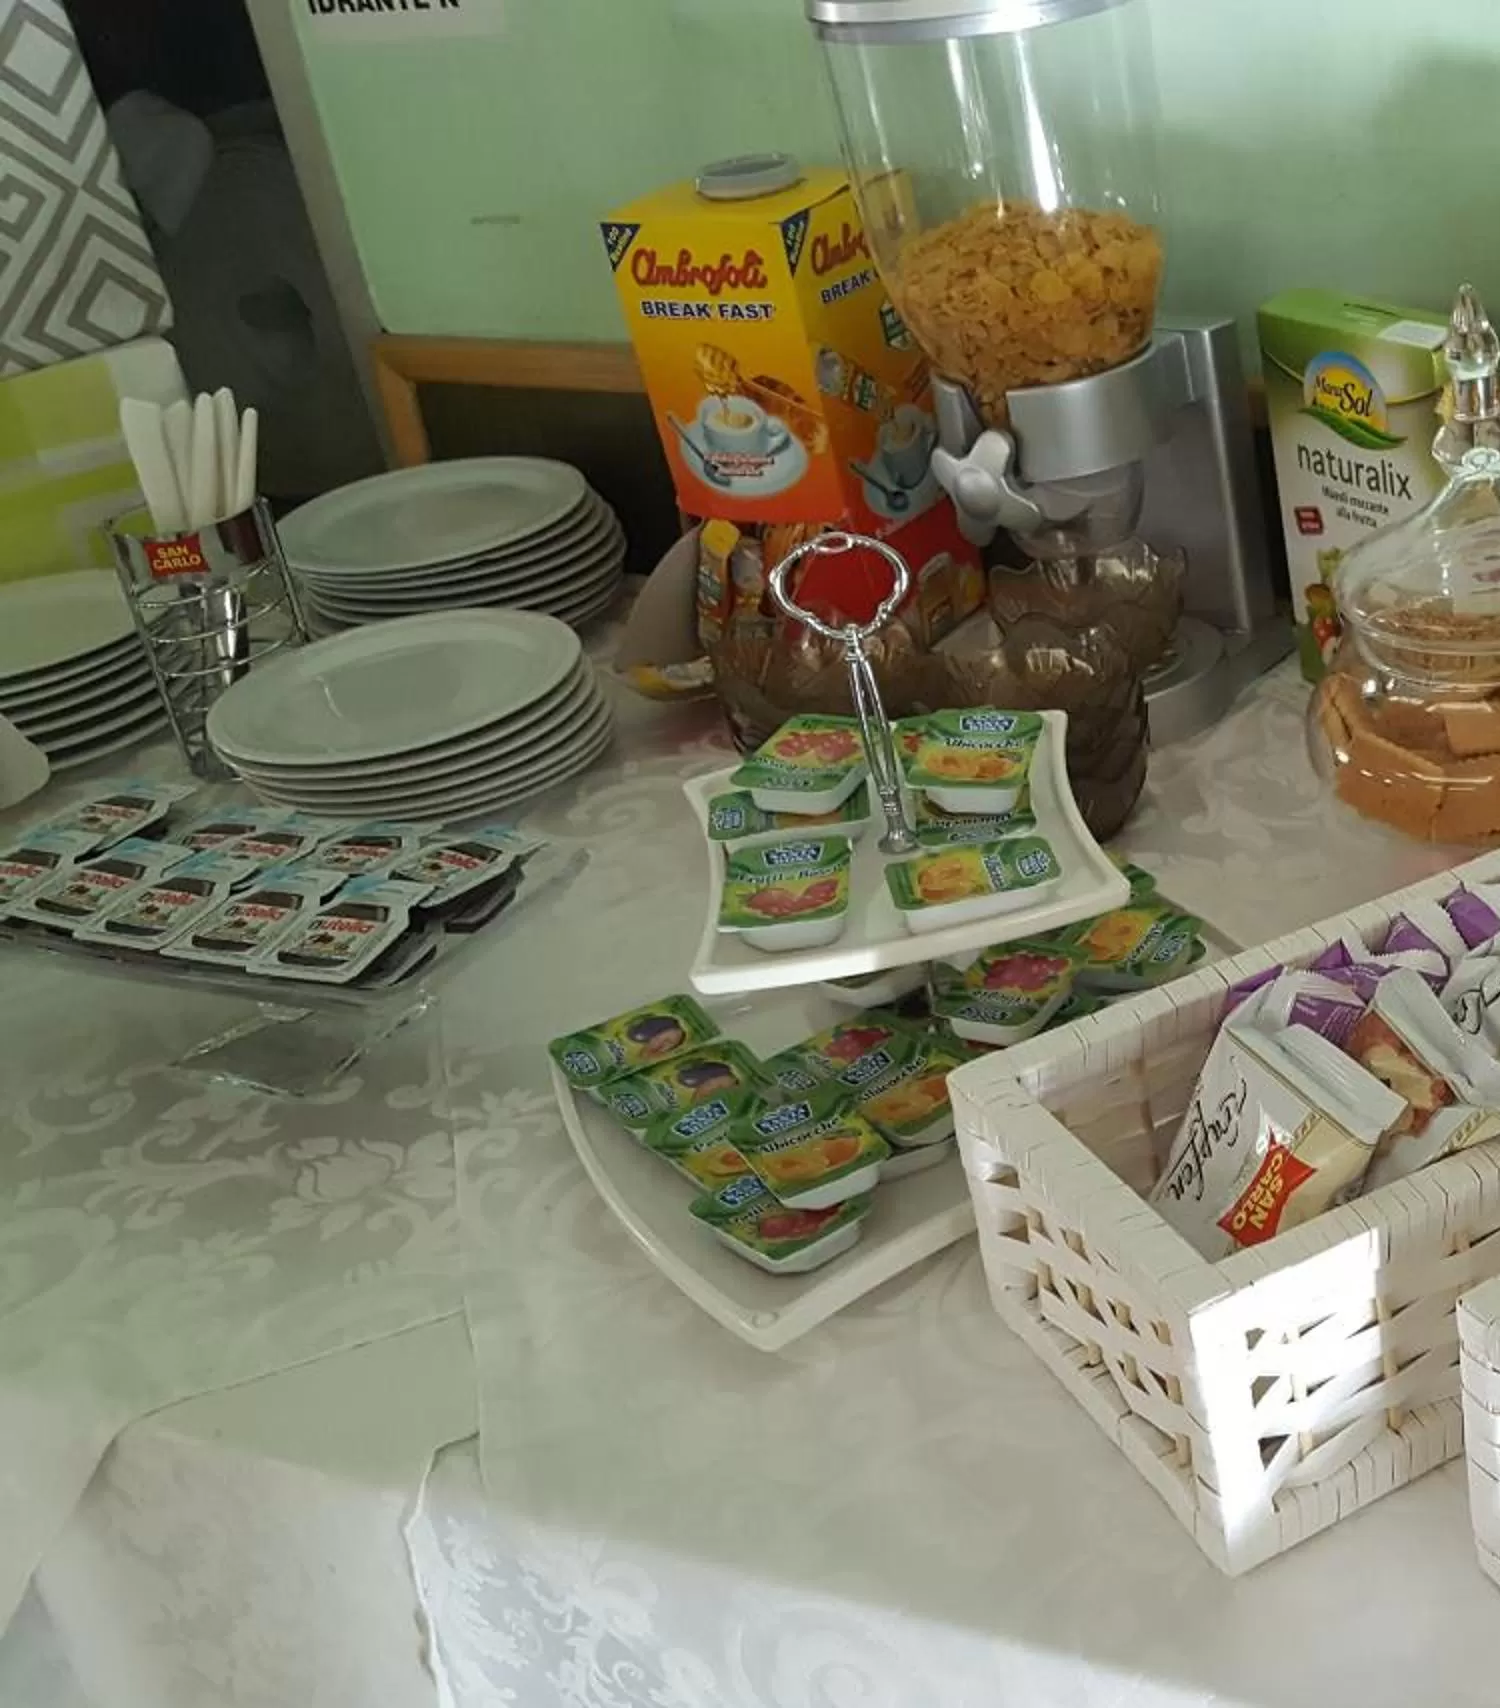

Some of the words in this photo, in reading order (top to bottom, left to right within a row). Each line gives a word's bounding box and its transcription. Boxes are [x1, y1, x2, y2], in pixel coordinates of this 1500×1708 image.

[631, 248, 767, 295] Ambrosoli
[821, 269, 871, 304] BREAK
[641, 301, 711, 320] BREAK
[718, 303, 772, 321] FAST
[1297, 443, 1412, 501] naturalix
[153, 553, 201, 571] CARLO
[156, 544, 189, 559] SAN
[1231, 1151, 1284, 1231] CARLO
[1252, 1175, 1284, 1231] SAN
